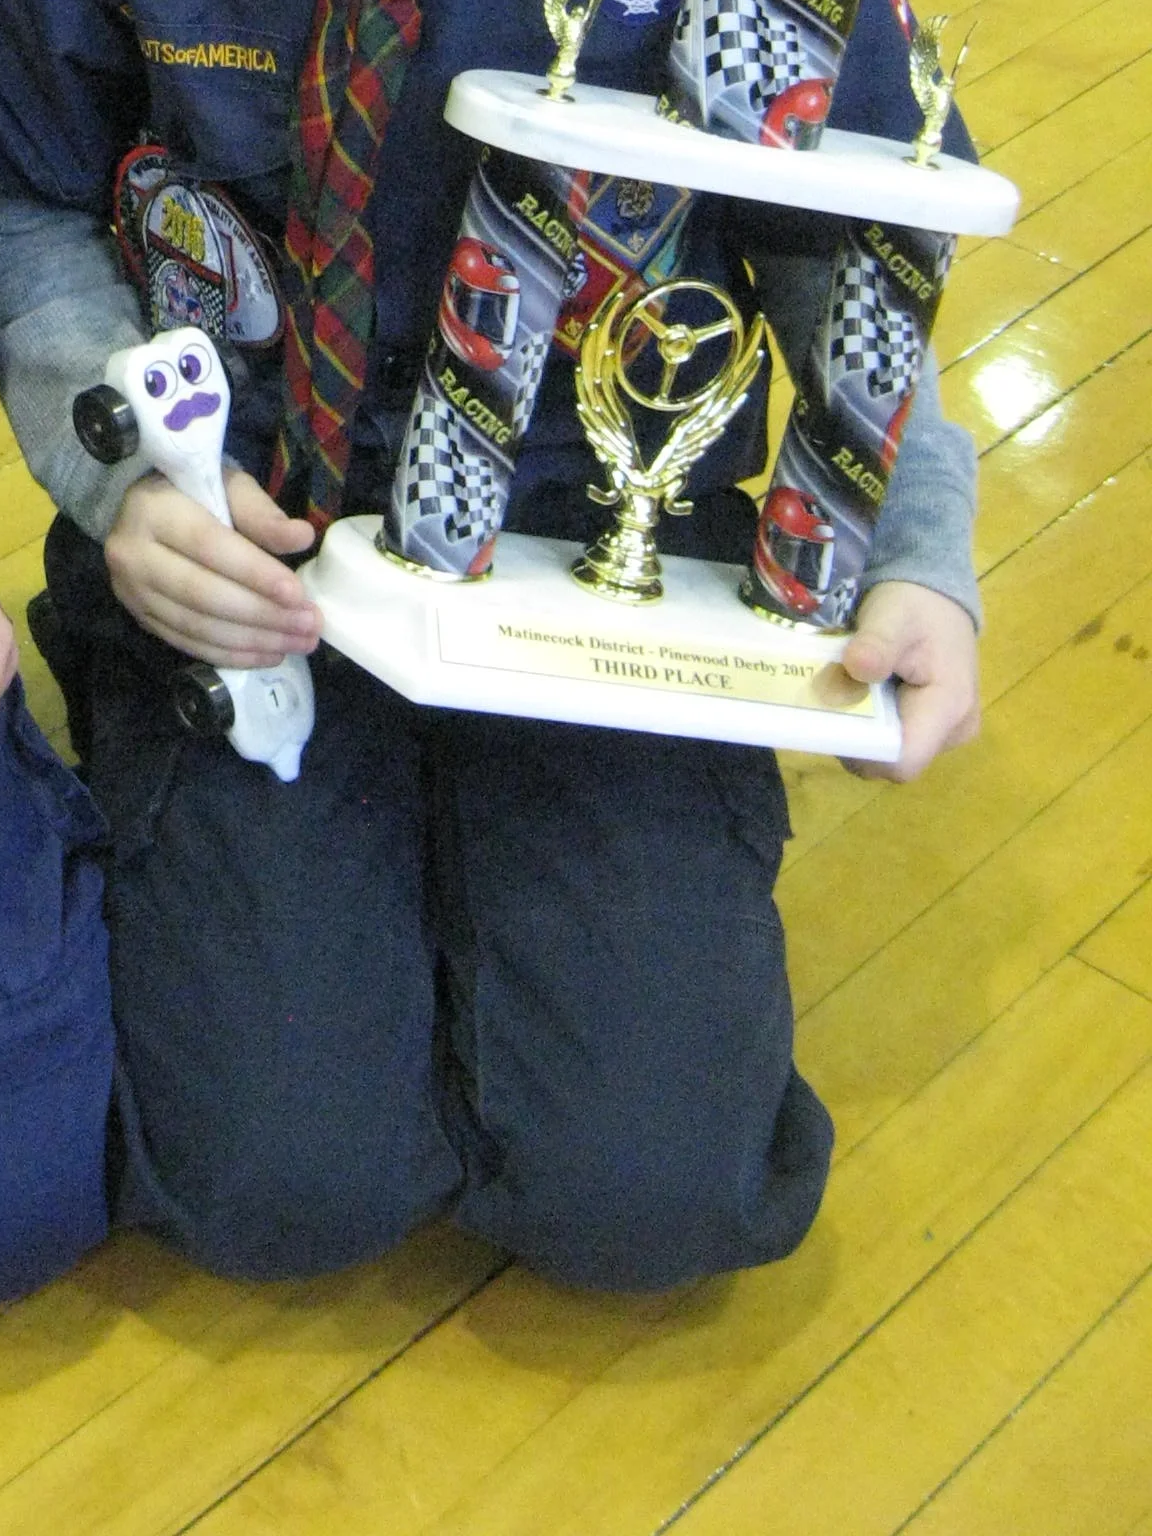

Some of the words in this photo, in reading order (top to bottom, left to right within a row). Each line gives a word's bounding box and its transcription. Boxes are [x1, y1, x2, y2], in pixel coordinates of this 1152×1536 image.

[193, 41, 277, 75] AMERICA
[864, 222, 933, 301] RACING
[436, 367, 513, 444] RACING
[497, 623, 585, 648] Matinecock
[588, 635, 647, 656] District
[658, 645, 730, 668] Pinewood
[733, 653, 778, 677] Derby
[782, 663, 815, 678] 2017
[590, 658, 658, 684] THIRD
[663, 666, 734, 691] PLACE
